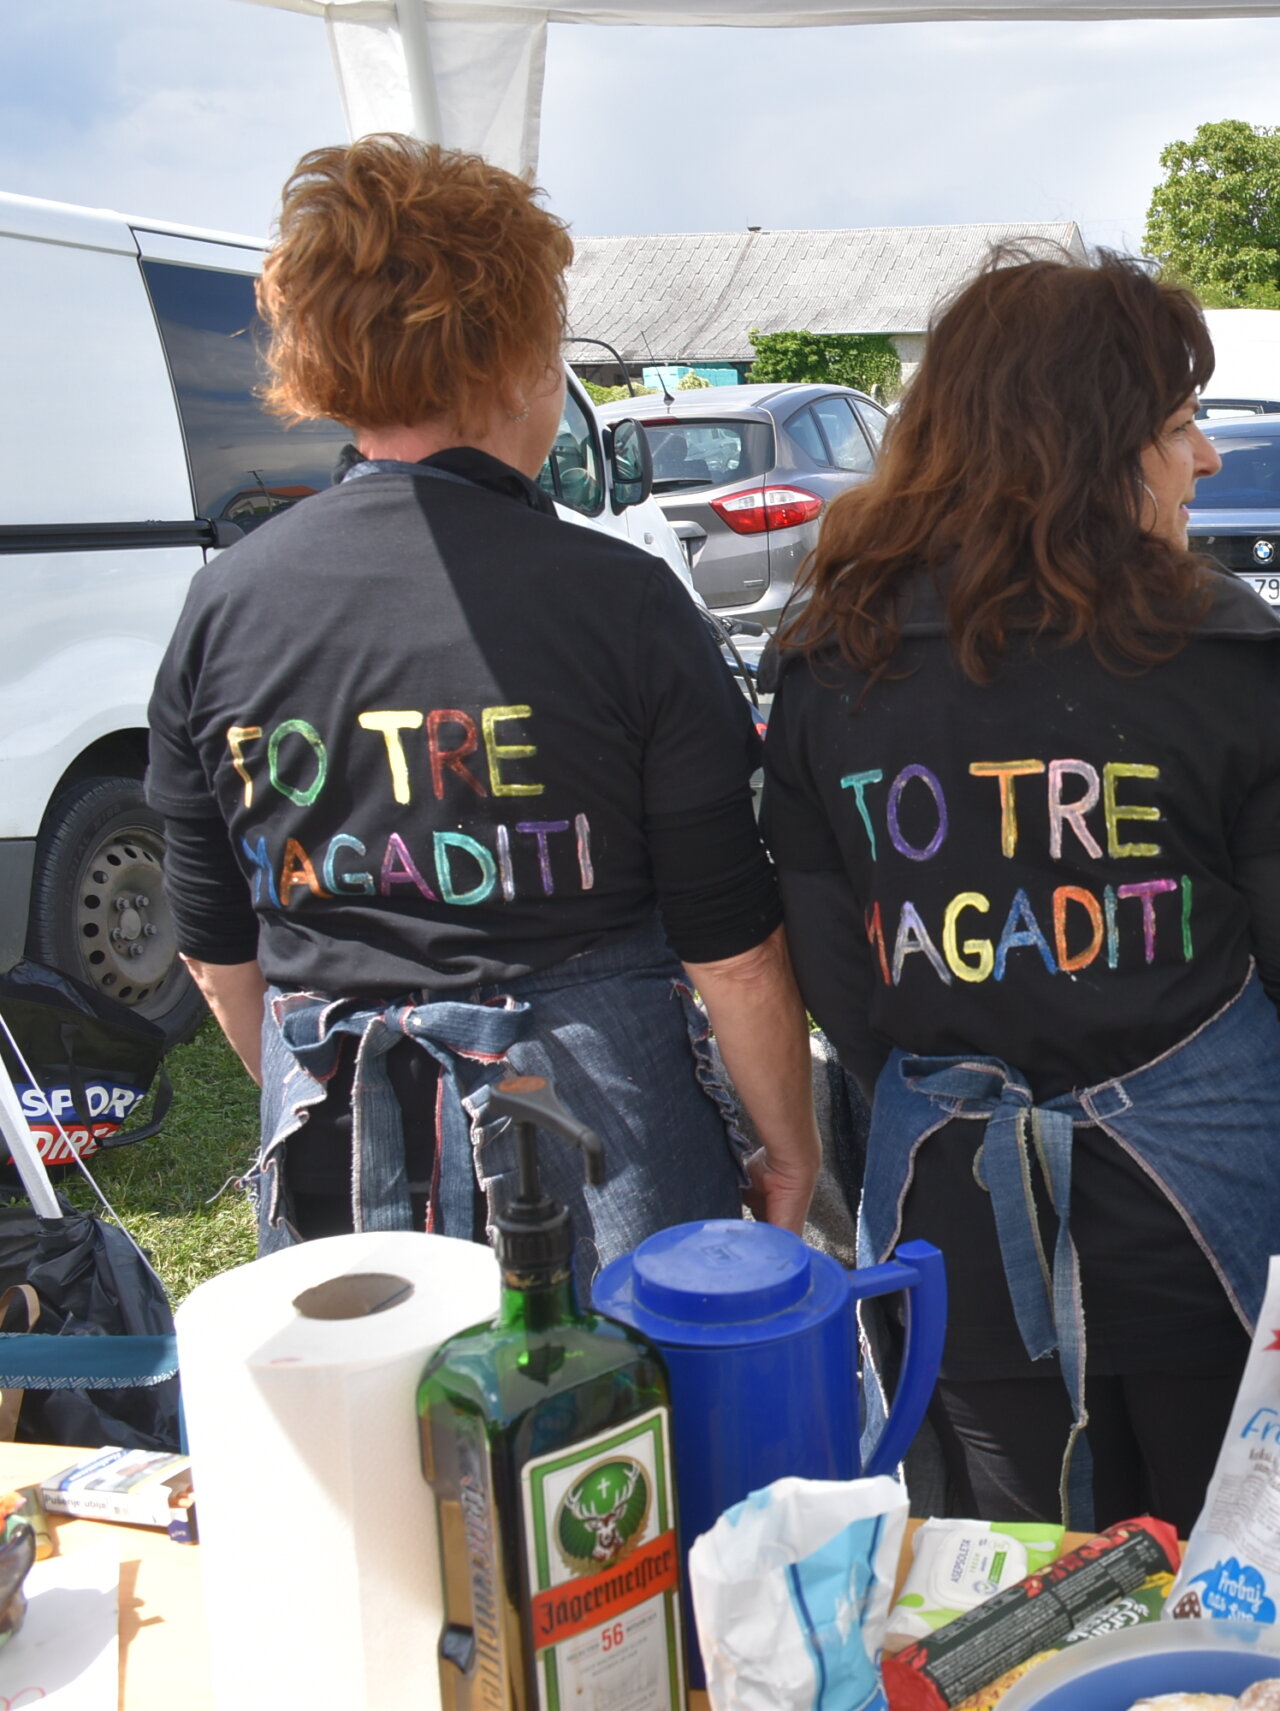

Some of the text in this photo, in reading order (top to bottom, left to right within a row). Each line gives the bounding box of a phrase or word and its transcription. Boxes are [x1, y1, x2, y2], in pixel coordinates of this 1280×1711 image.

[358, 704, 545, 805] TRE
[840, 758, 1162, 863] TO TRE
[240, 812, 594, 908] MAGADITI
[21, 1085, 147, 1118] SPOR
[601, 1622, 624, 1652] 56
